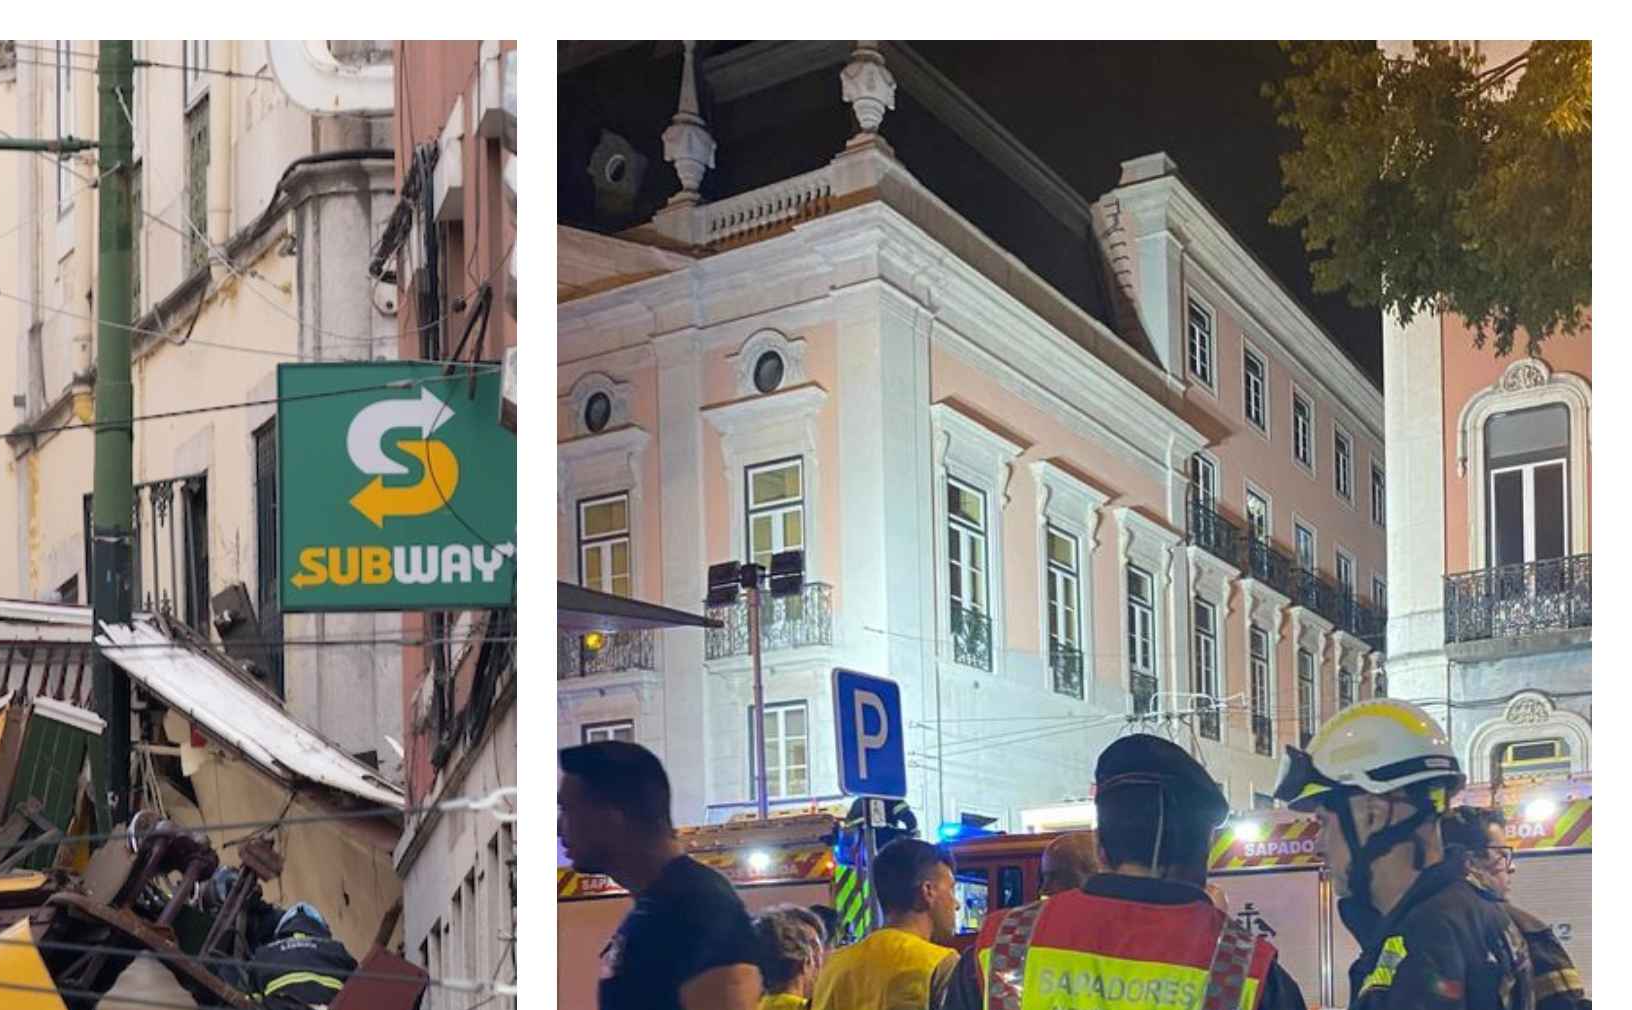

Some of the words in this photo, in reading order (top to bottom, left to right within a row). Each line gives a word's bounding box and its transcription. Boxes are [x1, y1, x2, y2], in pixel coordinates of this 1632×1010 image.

[290, 541, 515, 589] SUBWAY
[855, 689, 888, 780] P
[1245, 840, 1315, 857] SAPADO
[1040, 966, 1197, 1009] SAPADORES
